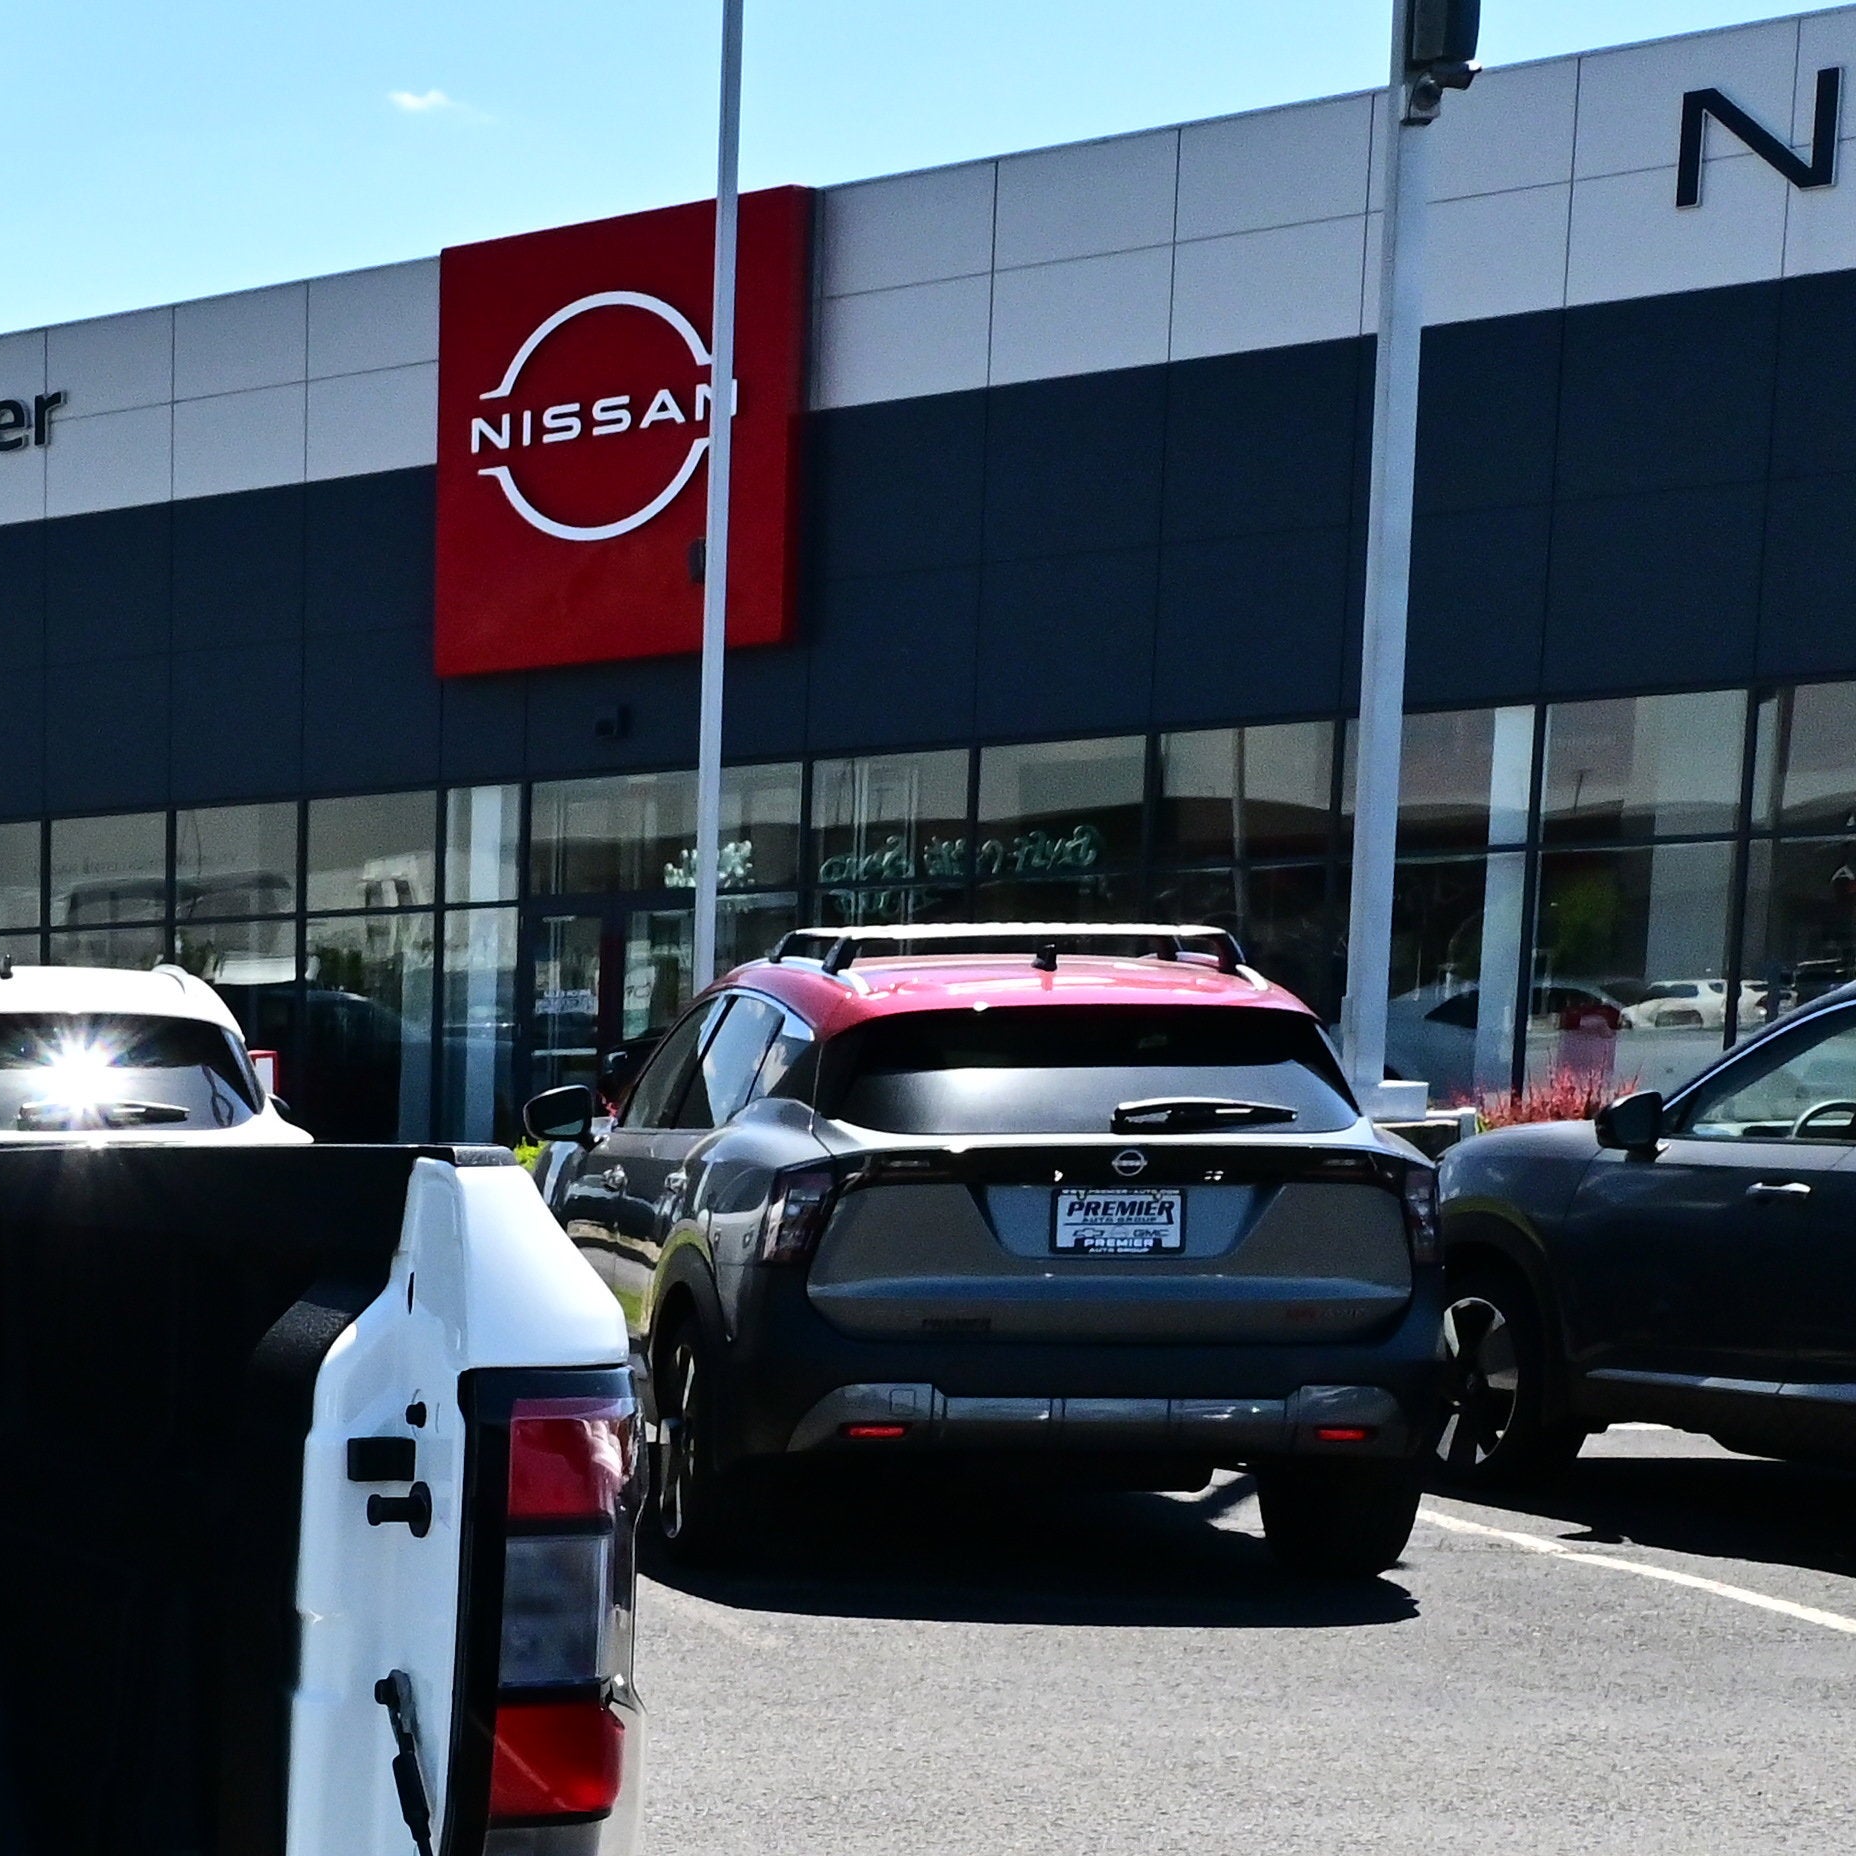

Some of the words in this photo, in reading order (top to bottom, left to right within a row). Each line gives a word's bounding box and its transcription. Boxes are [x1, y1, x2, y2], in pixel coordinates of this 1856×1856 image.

[471, 379, 737, 453] NISSAN
[1067, 1200, 1175, 1224] PREMIER
[1133, 1229, 1169, 1237] GMC
[1084, 1239, 1154, 1247] PREMIER
